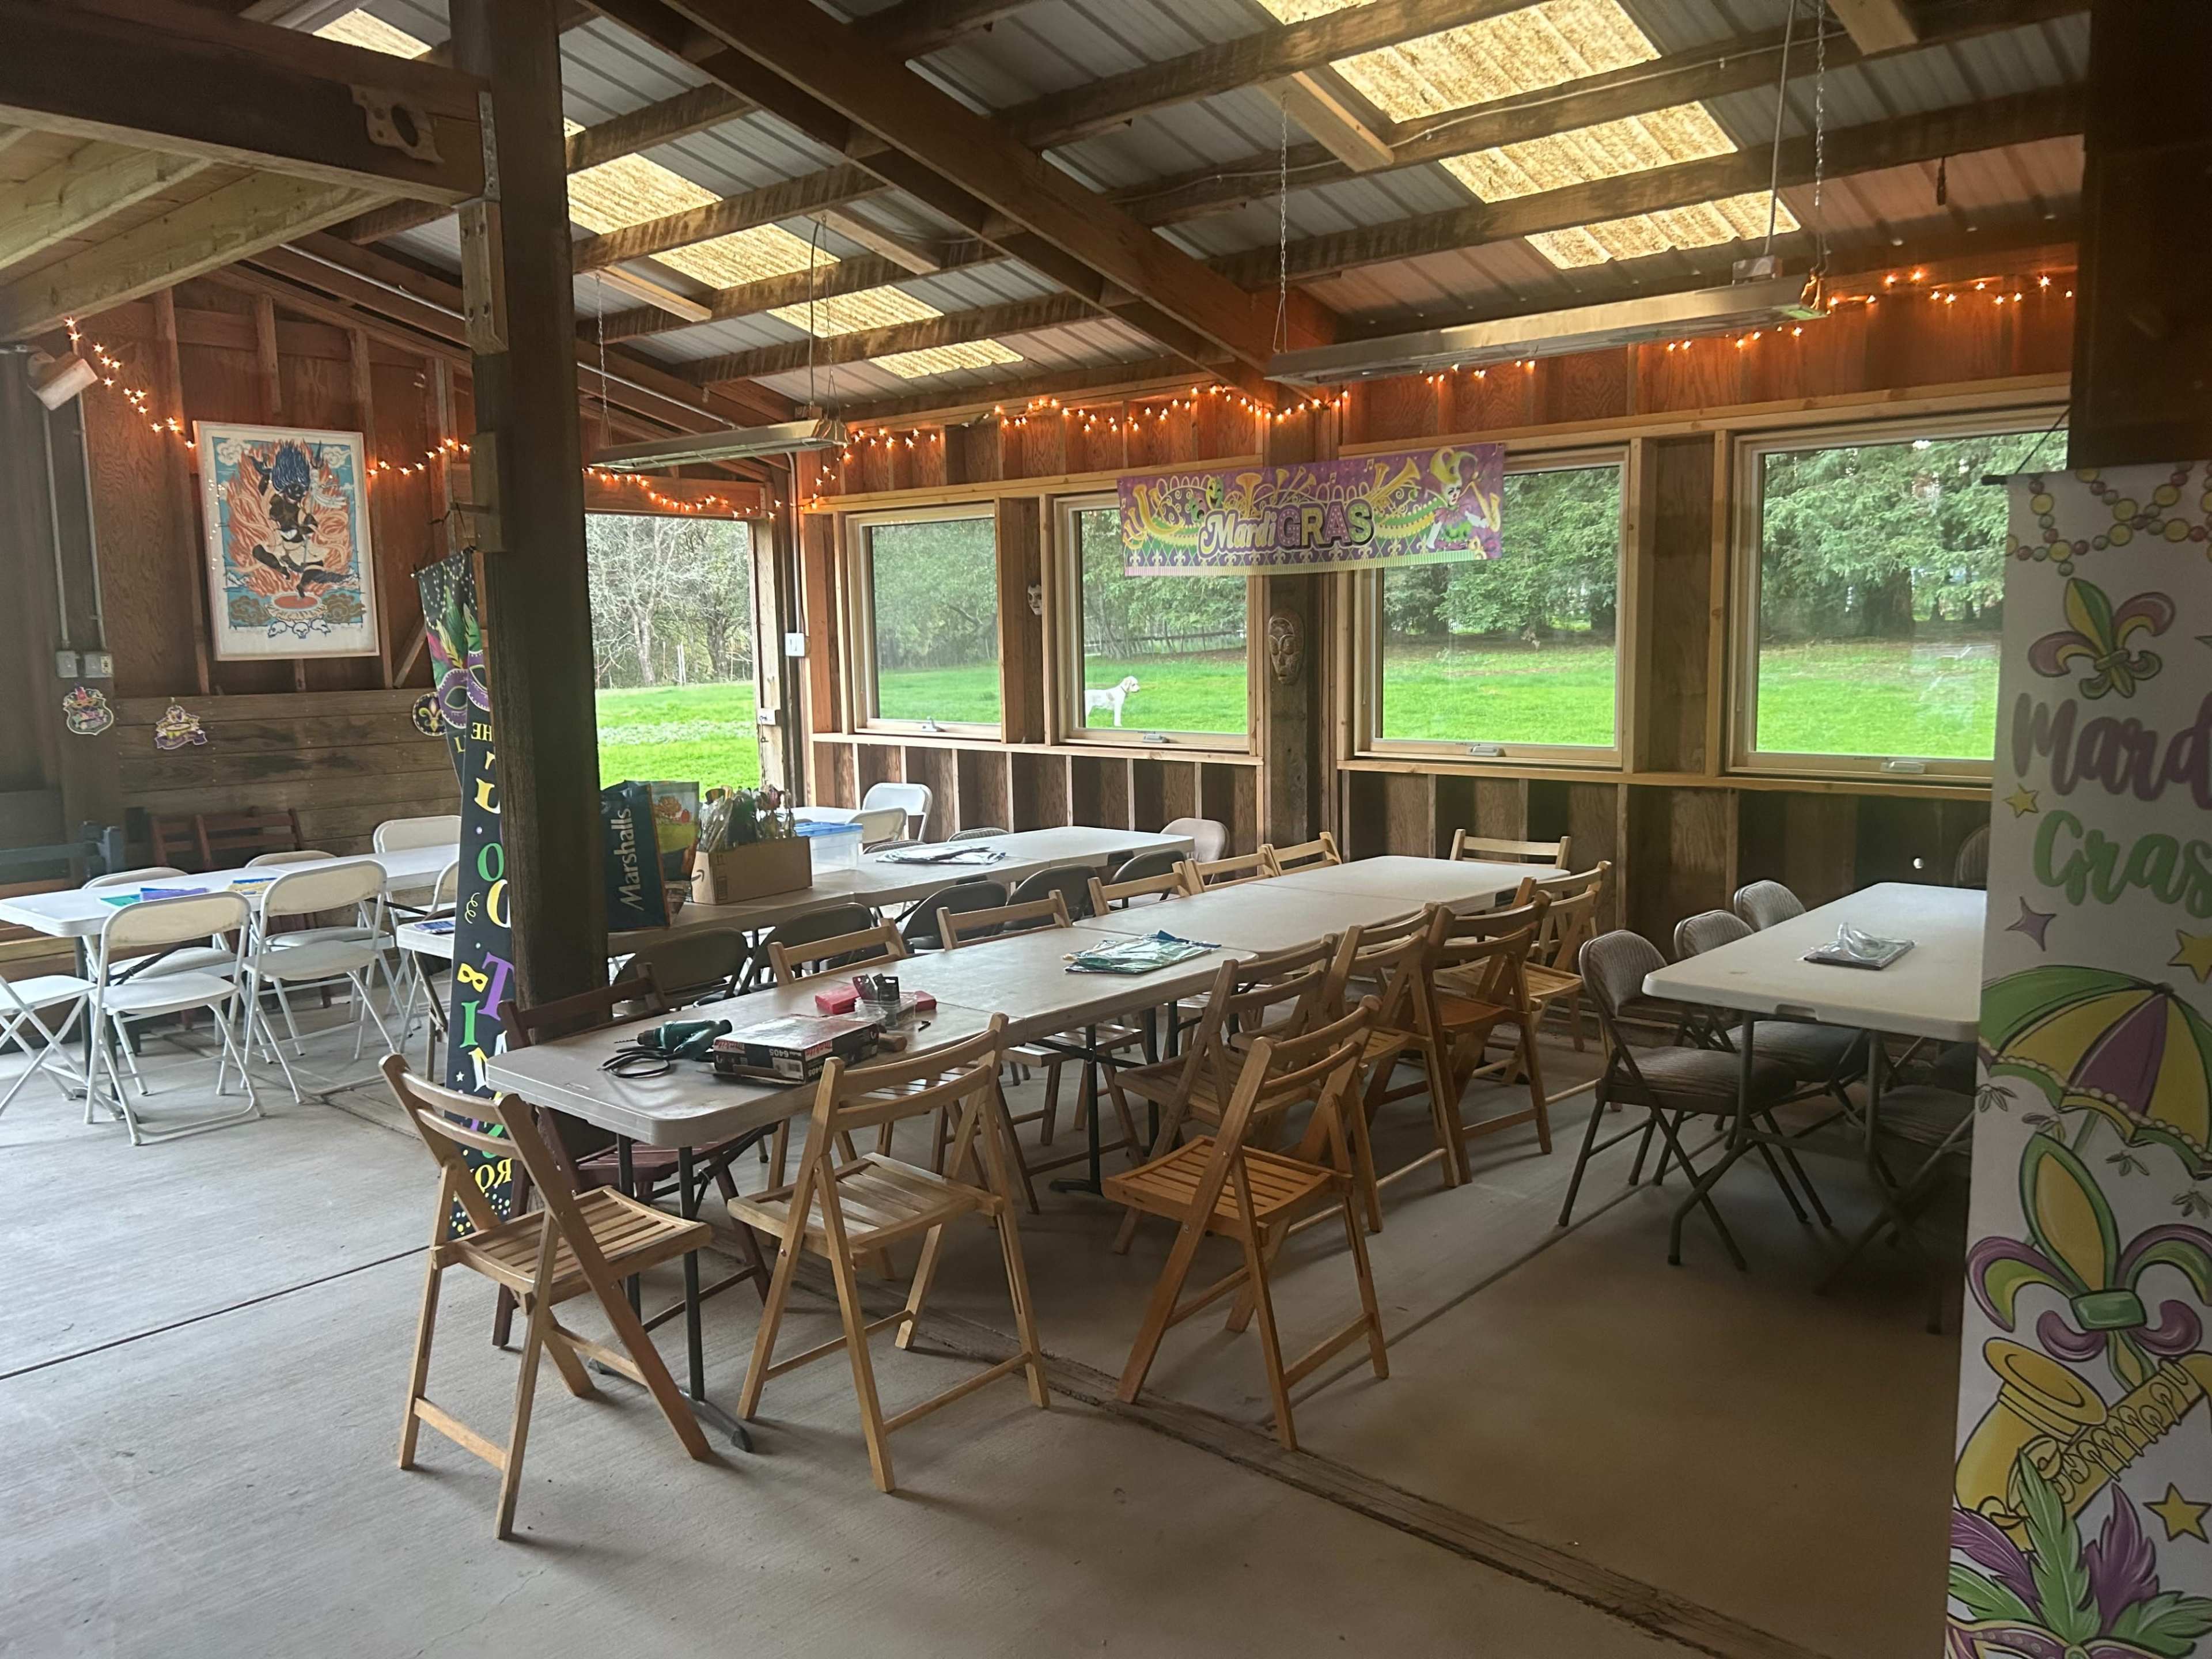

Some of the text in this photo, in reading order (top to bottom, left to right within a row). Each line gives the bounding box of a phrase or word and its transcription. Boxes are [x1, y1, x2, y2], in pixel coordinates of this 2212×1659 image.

[1200, 502, 1373, 554] Mardi GRAS
[2012, 691, 2212, 810] Mard
[611, 808, 645, 911] Marshalls
[2033, 810, 2212, 919] Gras
[769, 1048, 789, 1058] 6405
